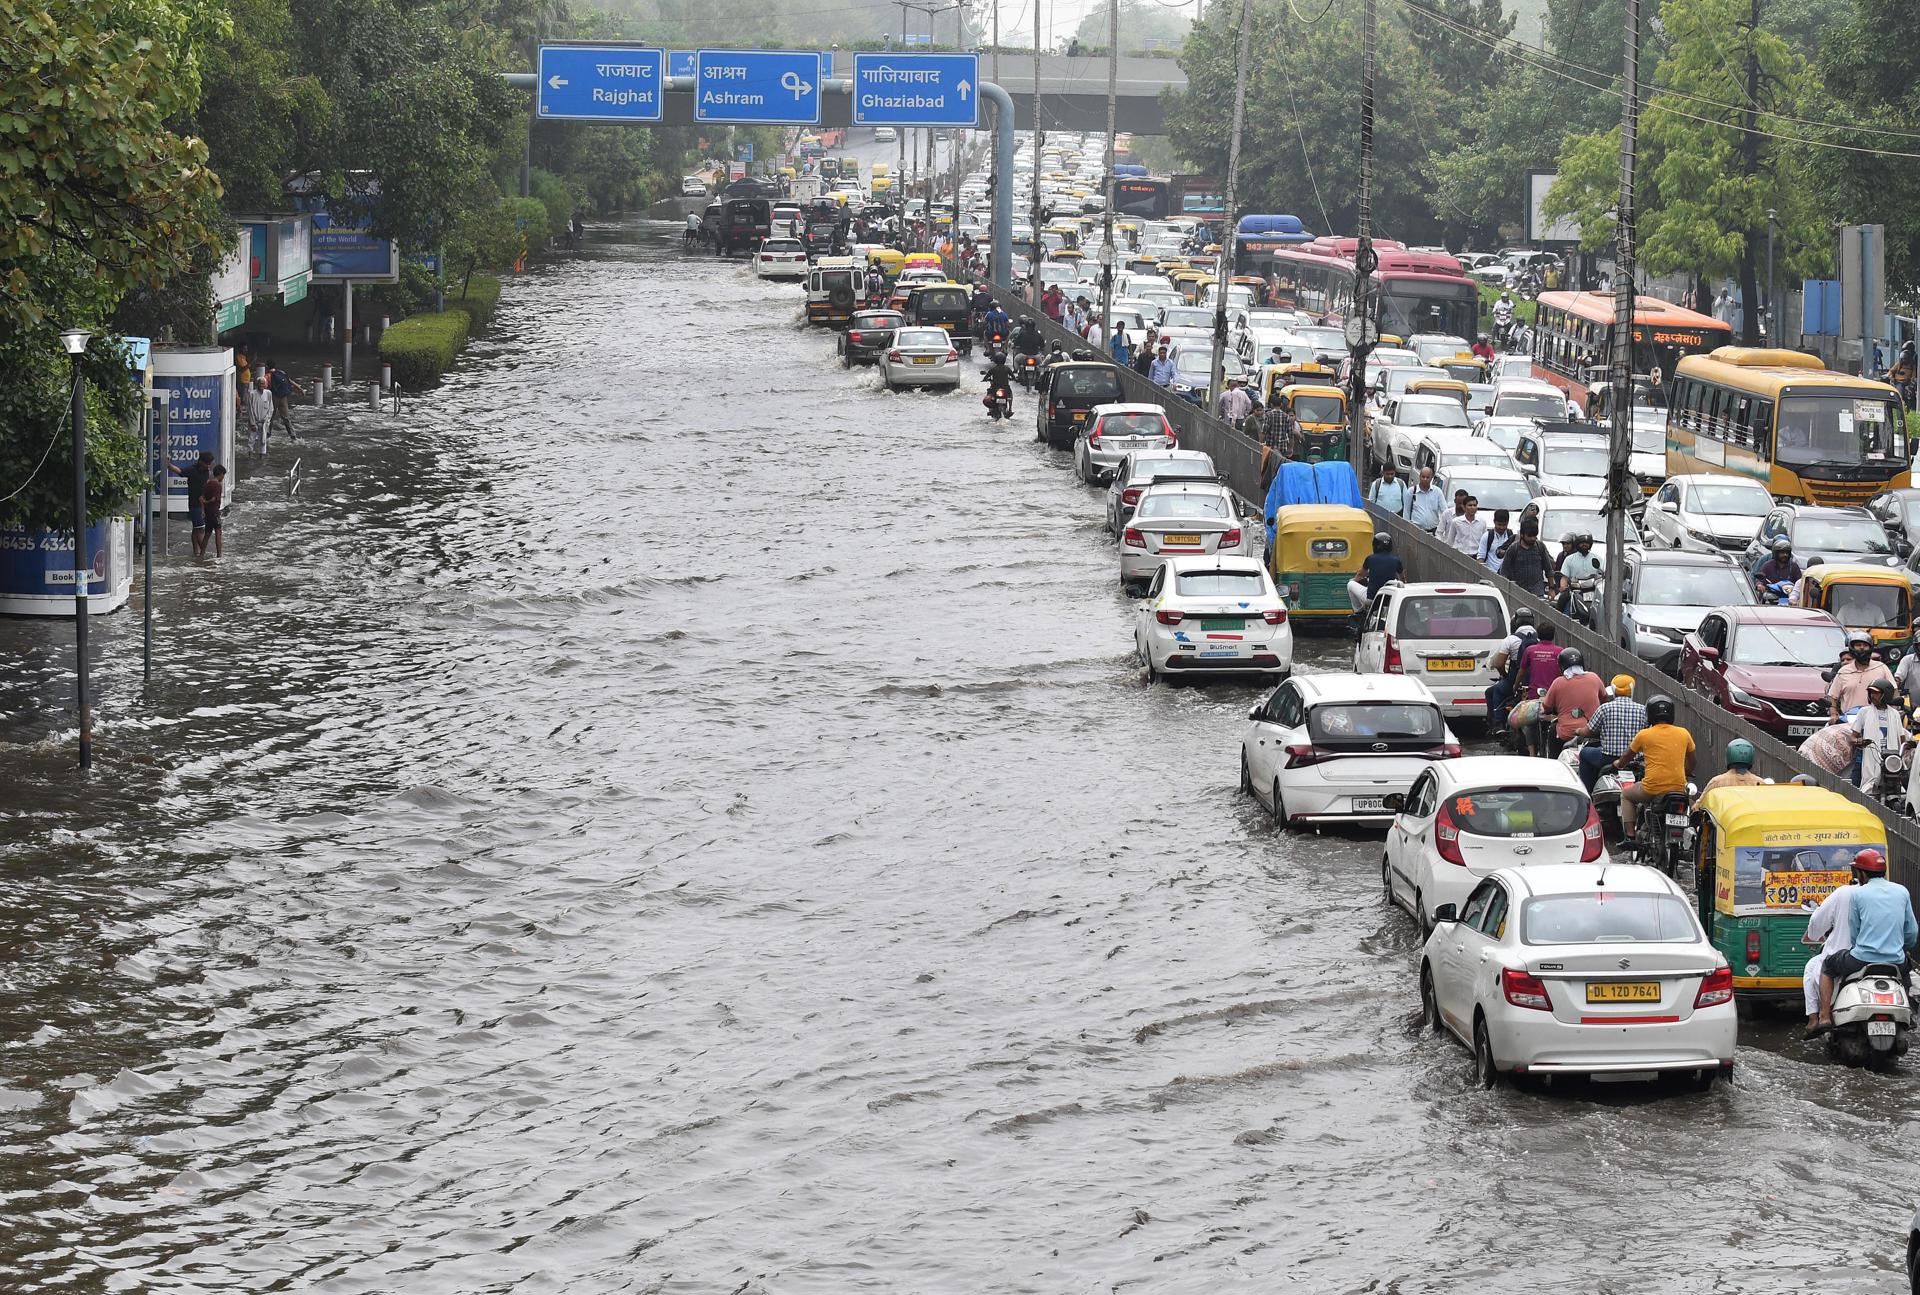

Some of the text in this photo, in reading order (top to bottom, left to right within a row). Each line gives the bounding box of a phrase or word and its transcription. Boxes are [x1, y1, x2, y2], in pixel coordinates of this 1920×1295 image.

[596, 64, 652, 78] राजघाट
[703, 65, 747, 80] आश्रम
[861, 65, 941, 83] गाजियाबाद
[593, 88, 653, 105] Rajghat
[703, 90, 764, 105] Ashram
[861, 94, 945, 108] Ghaziabad
[318, 235, 357, 243] of the World
[185, 387, 211, 399] Your
[183, 407, 211, 419] Here
[52, 573, 74, 581] Book
[1792, 727, 1801, 735] DL
[1802, 886, 1817, 894] FOR
[1818, 885, 1837, 894] AUTO
[1594, 986, 1607, 998] DL
[1632, 985, 1658, 997] 7641
